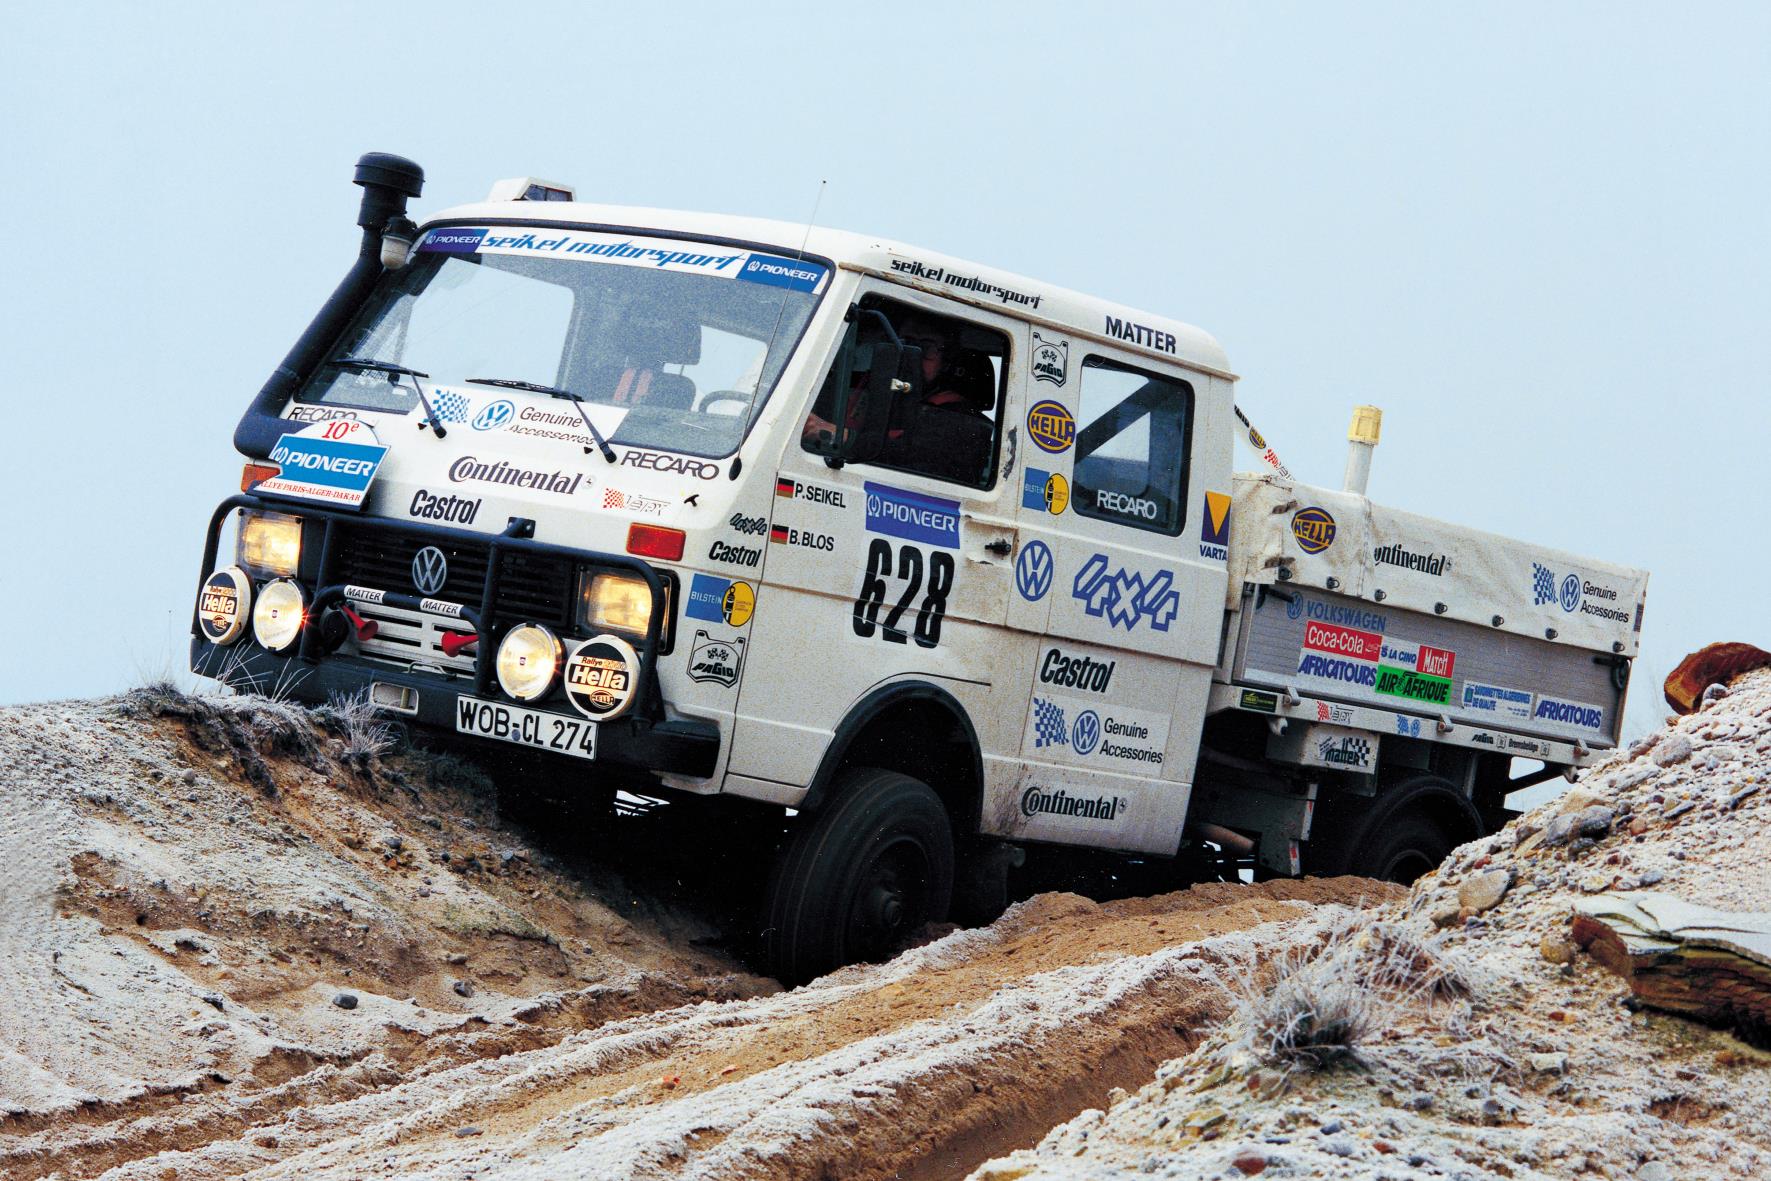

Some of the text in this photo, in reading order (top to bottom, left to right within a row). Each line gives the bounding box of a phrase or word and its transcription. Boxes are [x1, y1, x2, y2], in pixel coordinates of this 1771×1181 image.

[436, 234, 481, 245] PIONEER
[481, 234, 747, 270] seikel motorsport
[758, 262, 818, 282] PIONEER
[890, 258, 1044, 309] seikel motorsport
[1106, 315, 1176, 354] MATTER
[520, 406, 584, 428] Genuine
[1030, 412, 1075, 442] HELLA
[285, 451, 374, 477] PIONEER
[449, 455, 583, 495] Continental
[620, 450, 720, 480] RECARO
[409, 489, 482, 525] Castrol
[882, 500, 956, 533] PIONEER
[1096, 489, 1157, 520] RECARO
[1295, 519, 1336, 546] HELLA
[708, 540, 763, 568] Castrol
[1199, 544, 1228, 562] VARTA
[1374, 543, 1446, 577] ontinental
[203, 594, 236, 614] Hella
[346, 587, 381, 601] MATTER
[690, 591, 722, 604] BILSTEIN
[853, 538, 956, 650] 628
[1582, 580, 1618, 601] Genuine
[422, 600, 457, 614] MATTER
[1306, 600, 1387, 632] VOLKSWAGEN
[1580, 600, 1630, 623] Accessories
[1308, 625, 1364, 654] Coca-Cola
[581, 657, 603, 666] Rallye
[1040, 649, 1116, 693] Castrol
[1298, 654, 1378, 687] AFRICATOURS
[572, 666, 626, 690] Hella
[1377, 672, 1450, 702] AIR AFRIQUE
[1104, 717, 1148, 739] Genuine
[1535, 699, 1602, 729] AFRICATOURS
[550, 719, 594, 755] 274
[1099, 740, 1163, 764] Accessories
[1021, 786, 1119, 820] Continental
